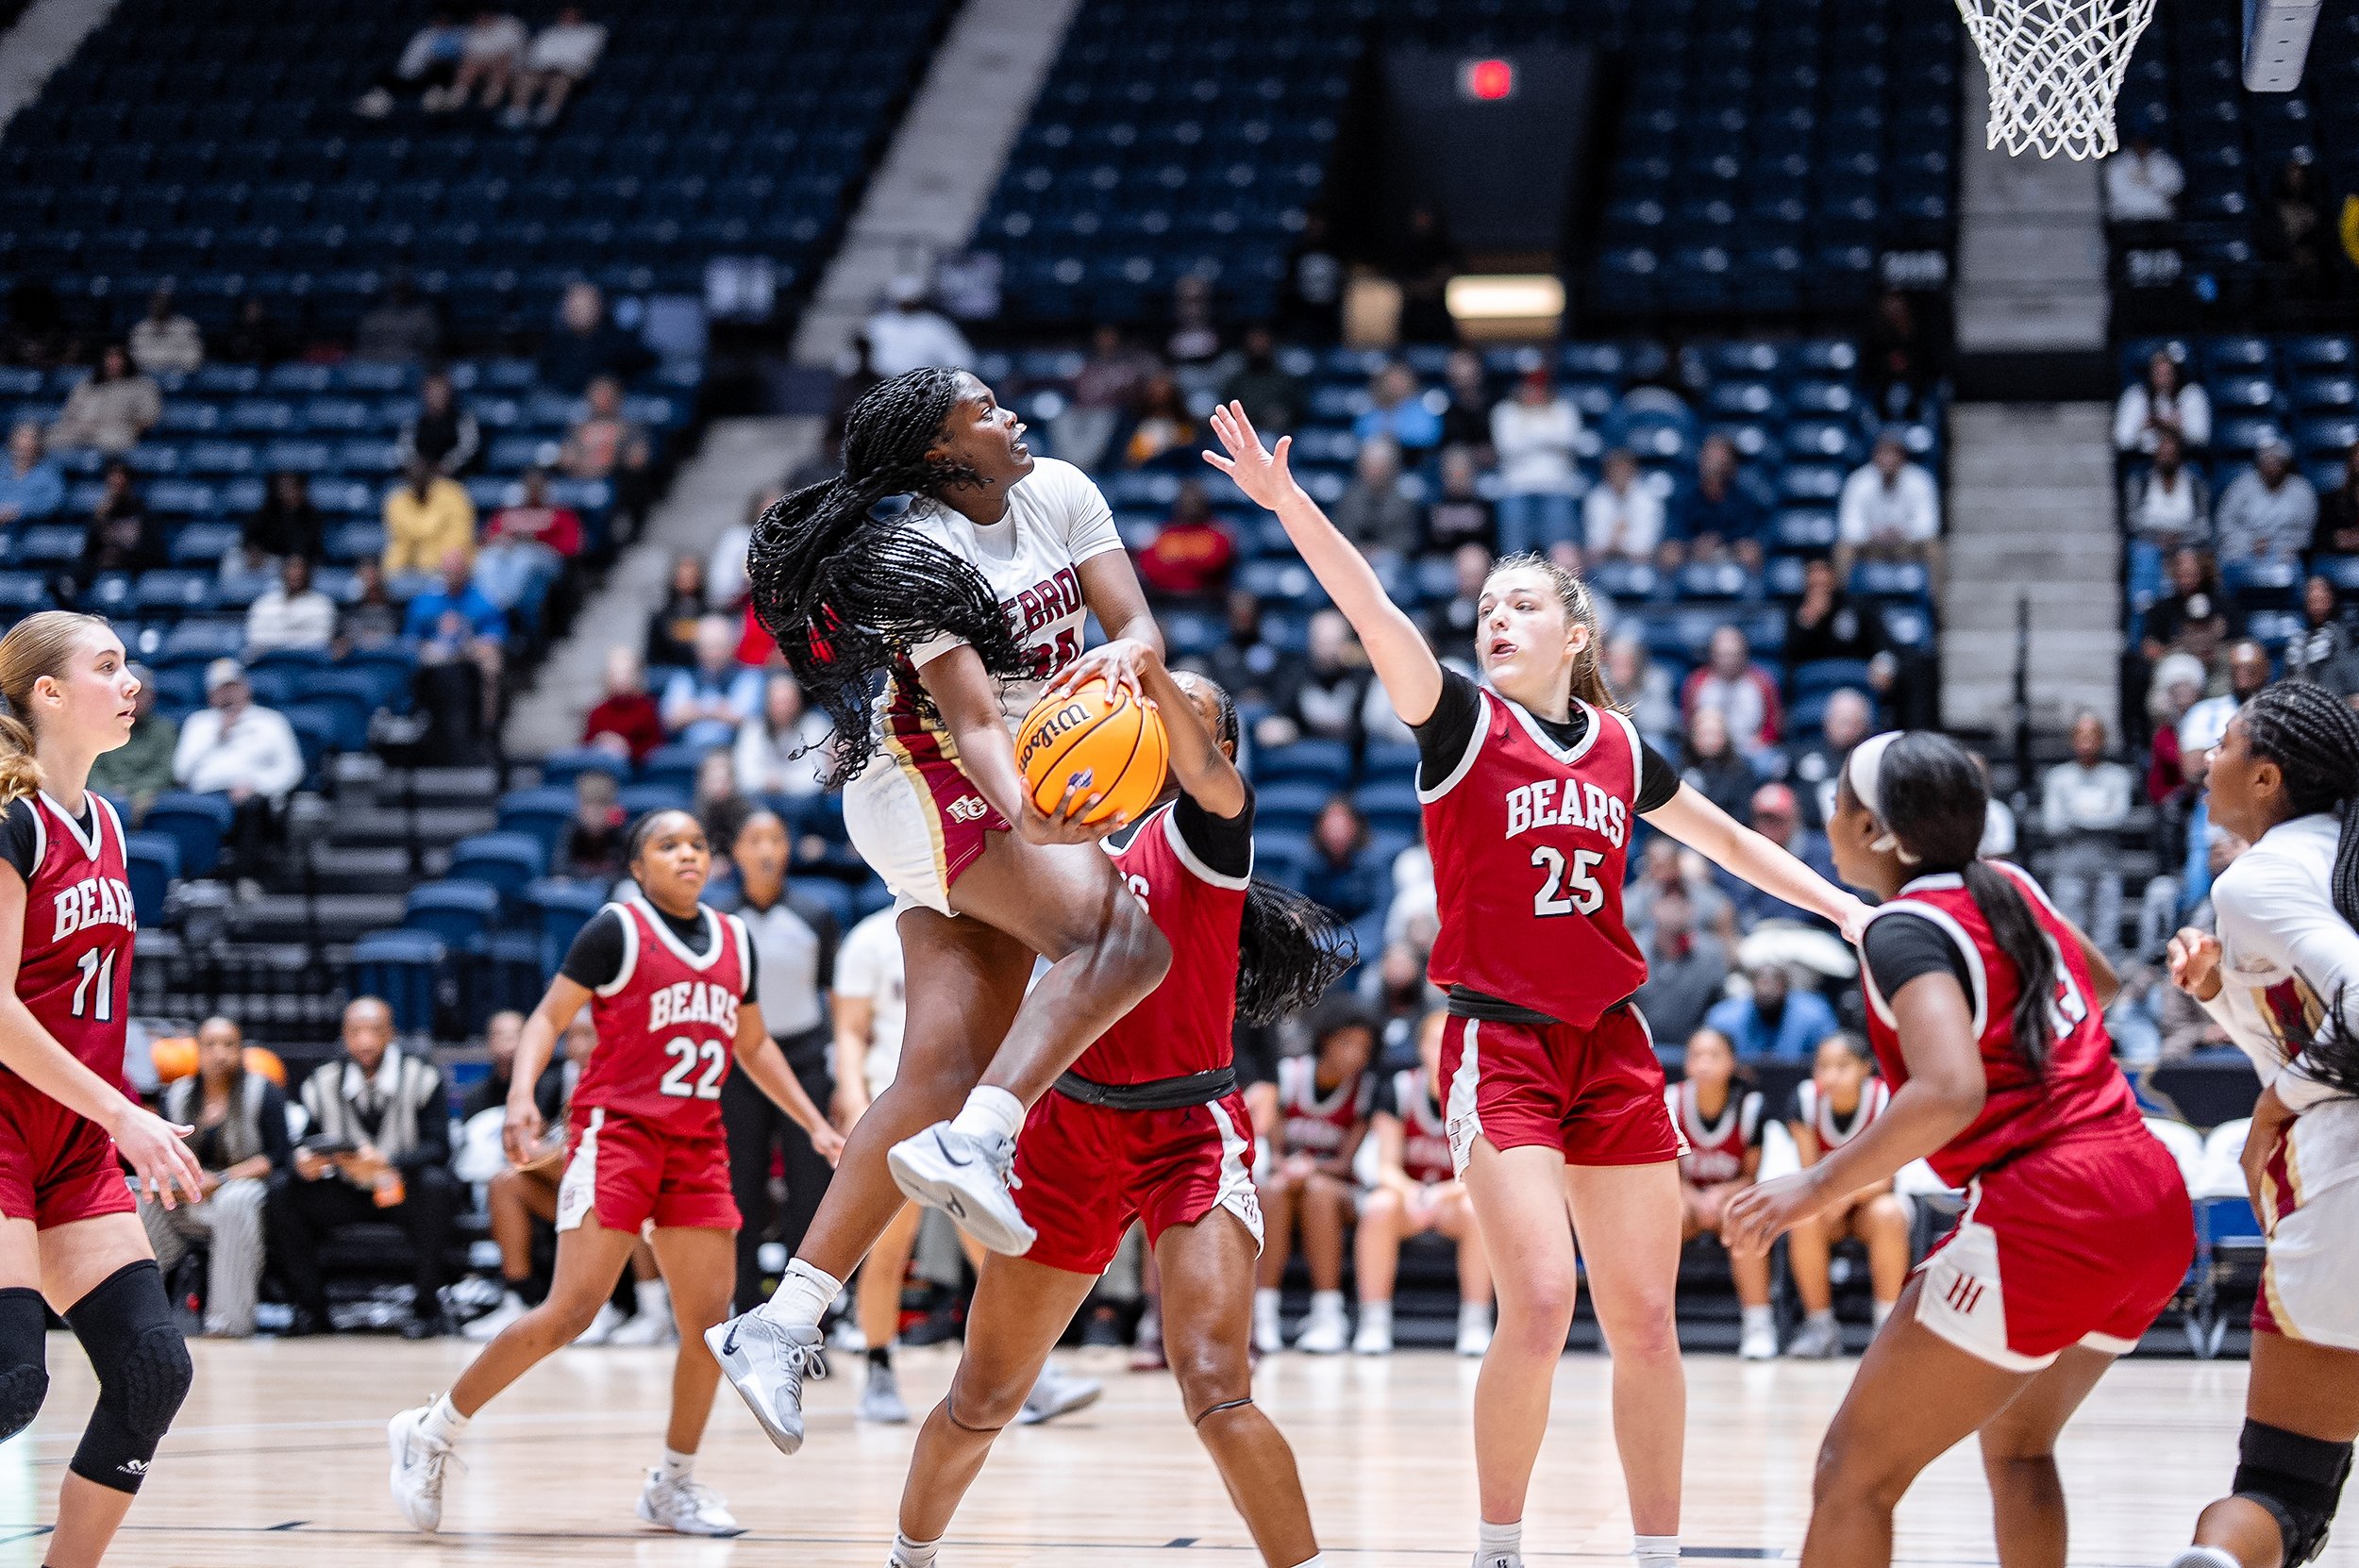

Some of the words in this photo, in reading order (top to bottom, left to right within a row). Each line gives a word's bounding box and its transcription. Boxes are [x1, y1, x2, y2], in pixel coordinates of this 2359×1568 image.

[998, 561, 1081, 642] EBRO
[1019, 704, 1091, 775] Wilson
[1505, 778, 1626, 849] BEARS
[52, 876, 138, 943] BEAR
[1531, 845, 1605, 917] 25
[71, 947, 114, 1022] 11
[647, 980, 740, 1039] BEARS
[660, 1036, 726, 1101] 22
